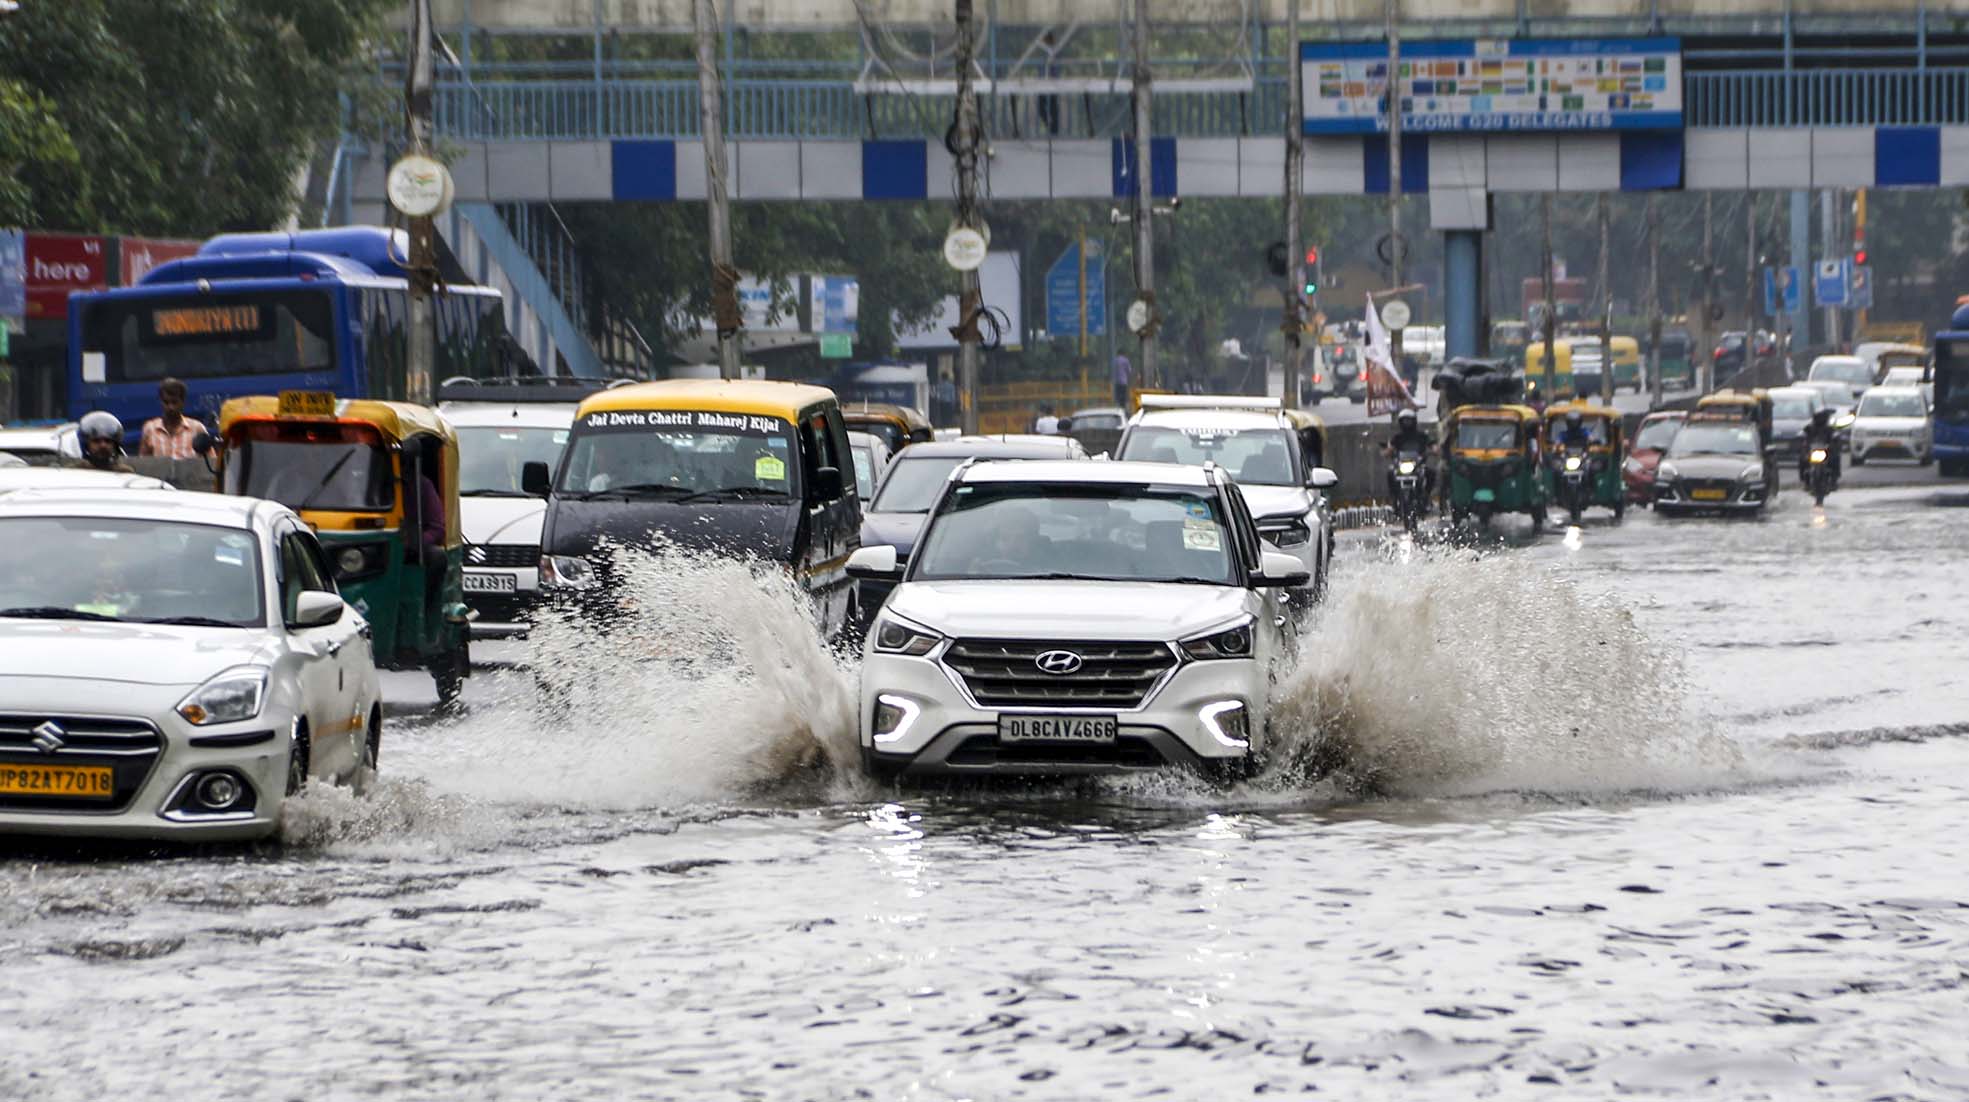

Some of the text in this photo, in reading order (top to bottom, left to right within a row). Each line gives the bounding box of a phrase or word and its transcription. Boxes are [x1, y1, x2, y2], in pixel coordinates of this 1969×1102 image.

[1375, 114, 1462, 131] WLCOME
[1508, 111, 1613, 129] DELEGATES
[34, 256, 90, 281] here
[587, 412, 608, 427] Jai
[610, 412, 645, 425] Devta
[648, 411, 692, 425] Chattri
[1011, 719, 1113, 738] DL8CAV4666
